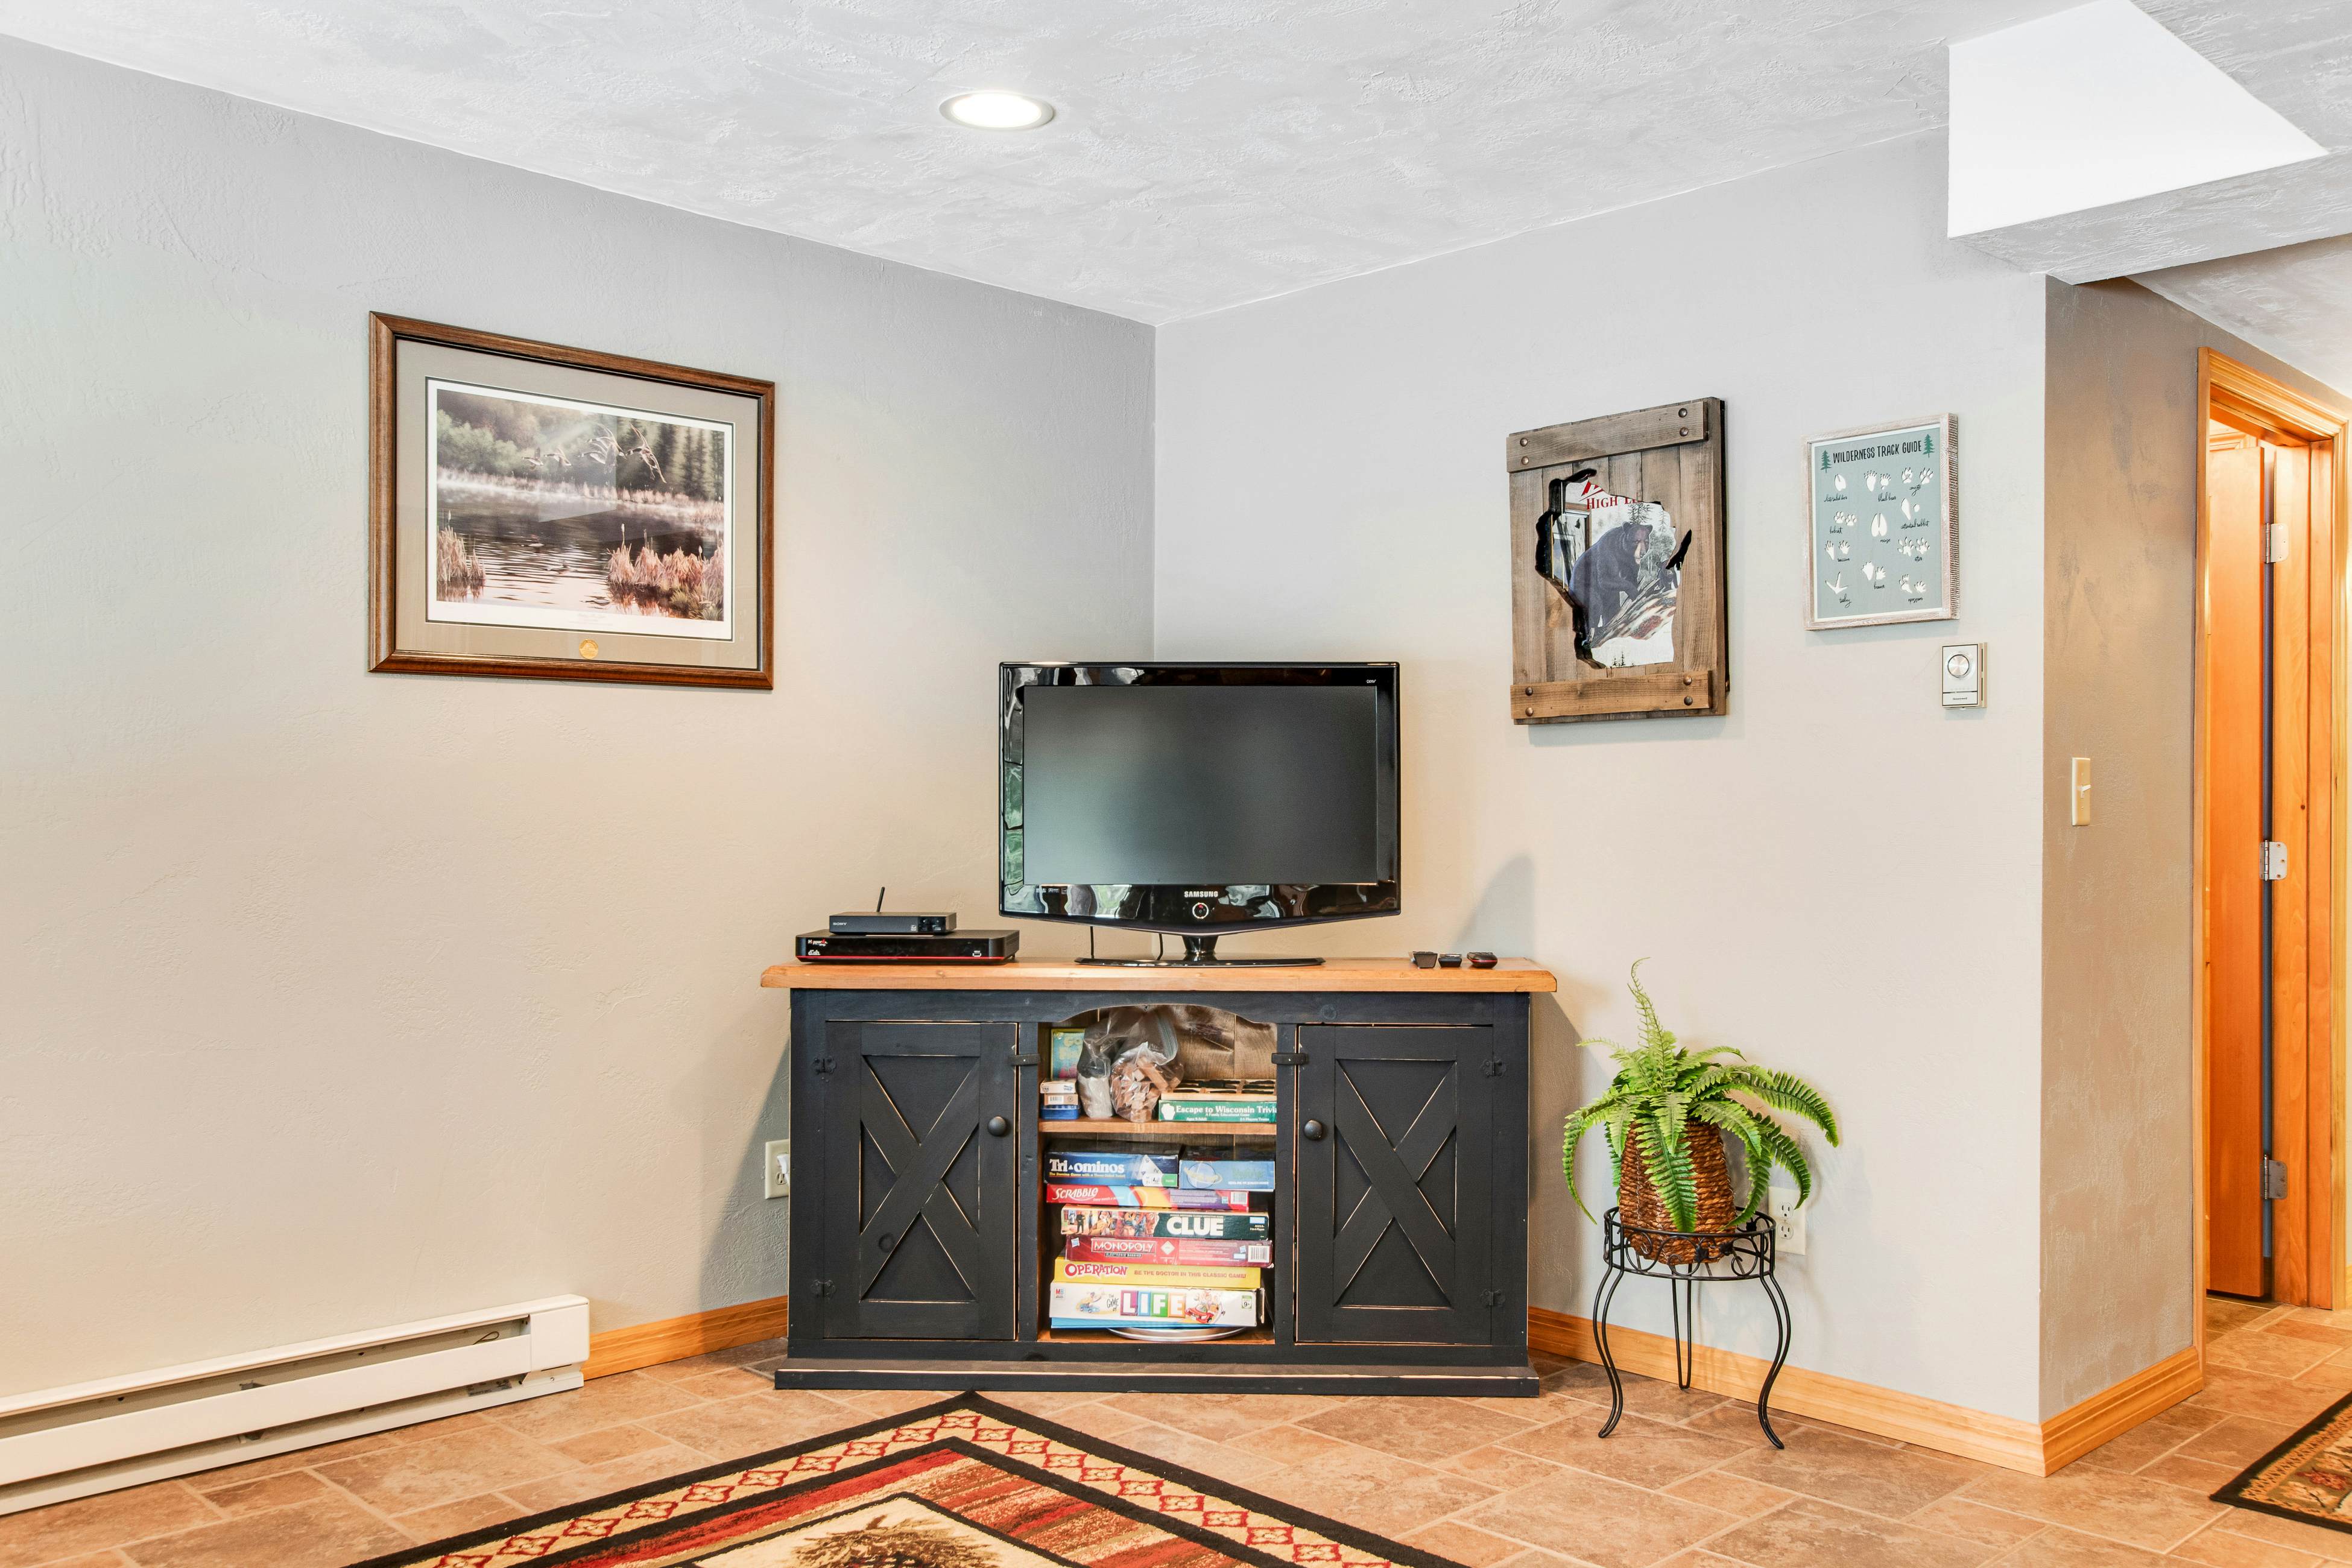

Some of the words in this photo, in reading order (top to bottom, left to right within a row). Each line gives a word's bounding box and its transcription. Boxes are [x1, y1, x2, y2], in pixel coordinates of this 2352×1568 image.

[1833, 447, 1875, 464] WILDERNESS
[1877, 443, 1900, 457] TRACK
[1902, 440, 1922, 454] GUIDE
[1587, 496, 1618, 510] HIGH
[1176, 1105, 1204, 1114] Escape
[1215, 1105, 1255, 1114] Wisconsin
[1055, 1187, 1099, 1200] SCRABBLE
[1166, 1216, 1224, 1236] CLUE
[1094, 1241, 1155, 1253] MONOPOLY
[1064, 1263, 1128, 1277] OPERATION
[1107, 1297, 1119, 1309] GAME
[1122, 1292, 1185, 1317] LIFE
